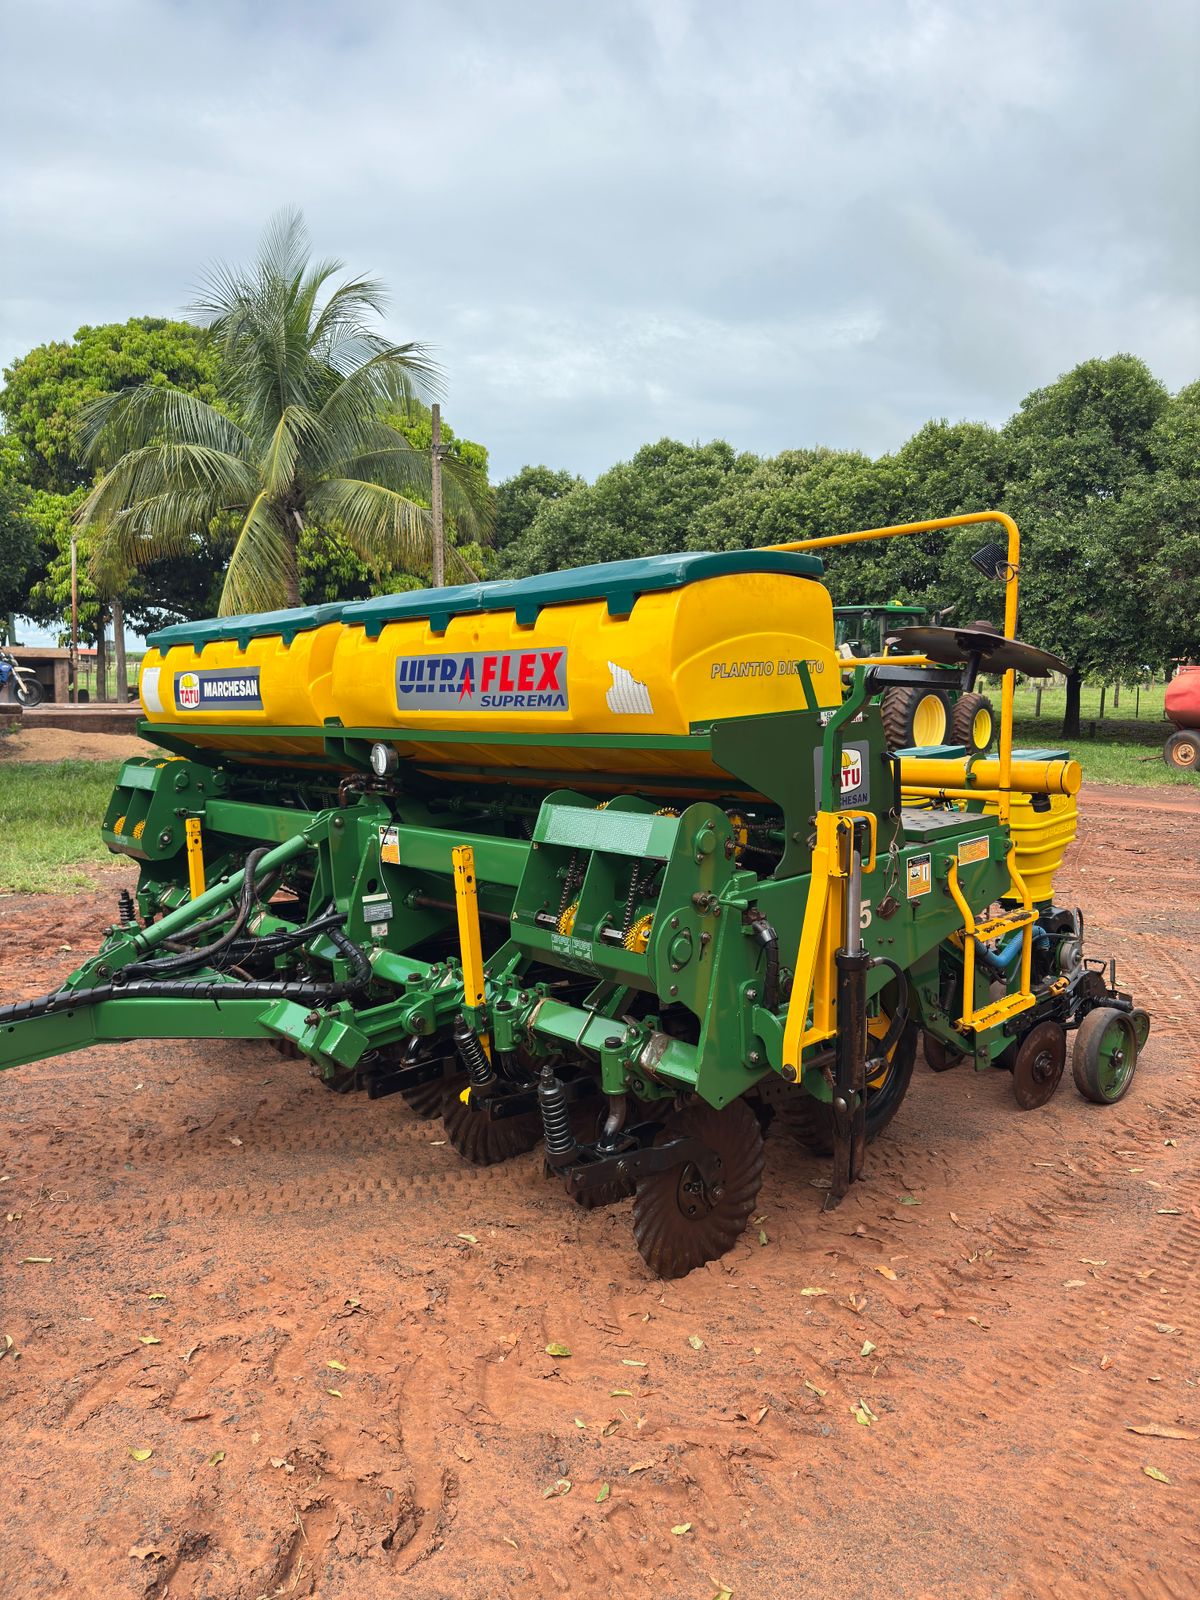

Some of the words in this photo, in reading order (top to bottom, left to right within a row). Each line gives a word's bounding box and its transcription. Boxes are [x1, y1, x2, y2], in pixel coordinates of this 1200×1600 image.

[399, 657, 476, 694] ULTRA
[480, 651, 564, 693] FLEX
[711, 661, 775, 679] PLANTIO
[777, 659, 825, 676] DIRTO
[180, 689, 199, 704] TATU
[203, 679, 258, 698] MARCHESAN
[480, 694, 566, 708] SUPREMA
[859, 899, 872, 929] 5
